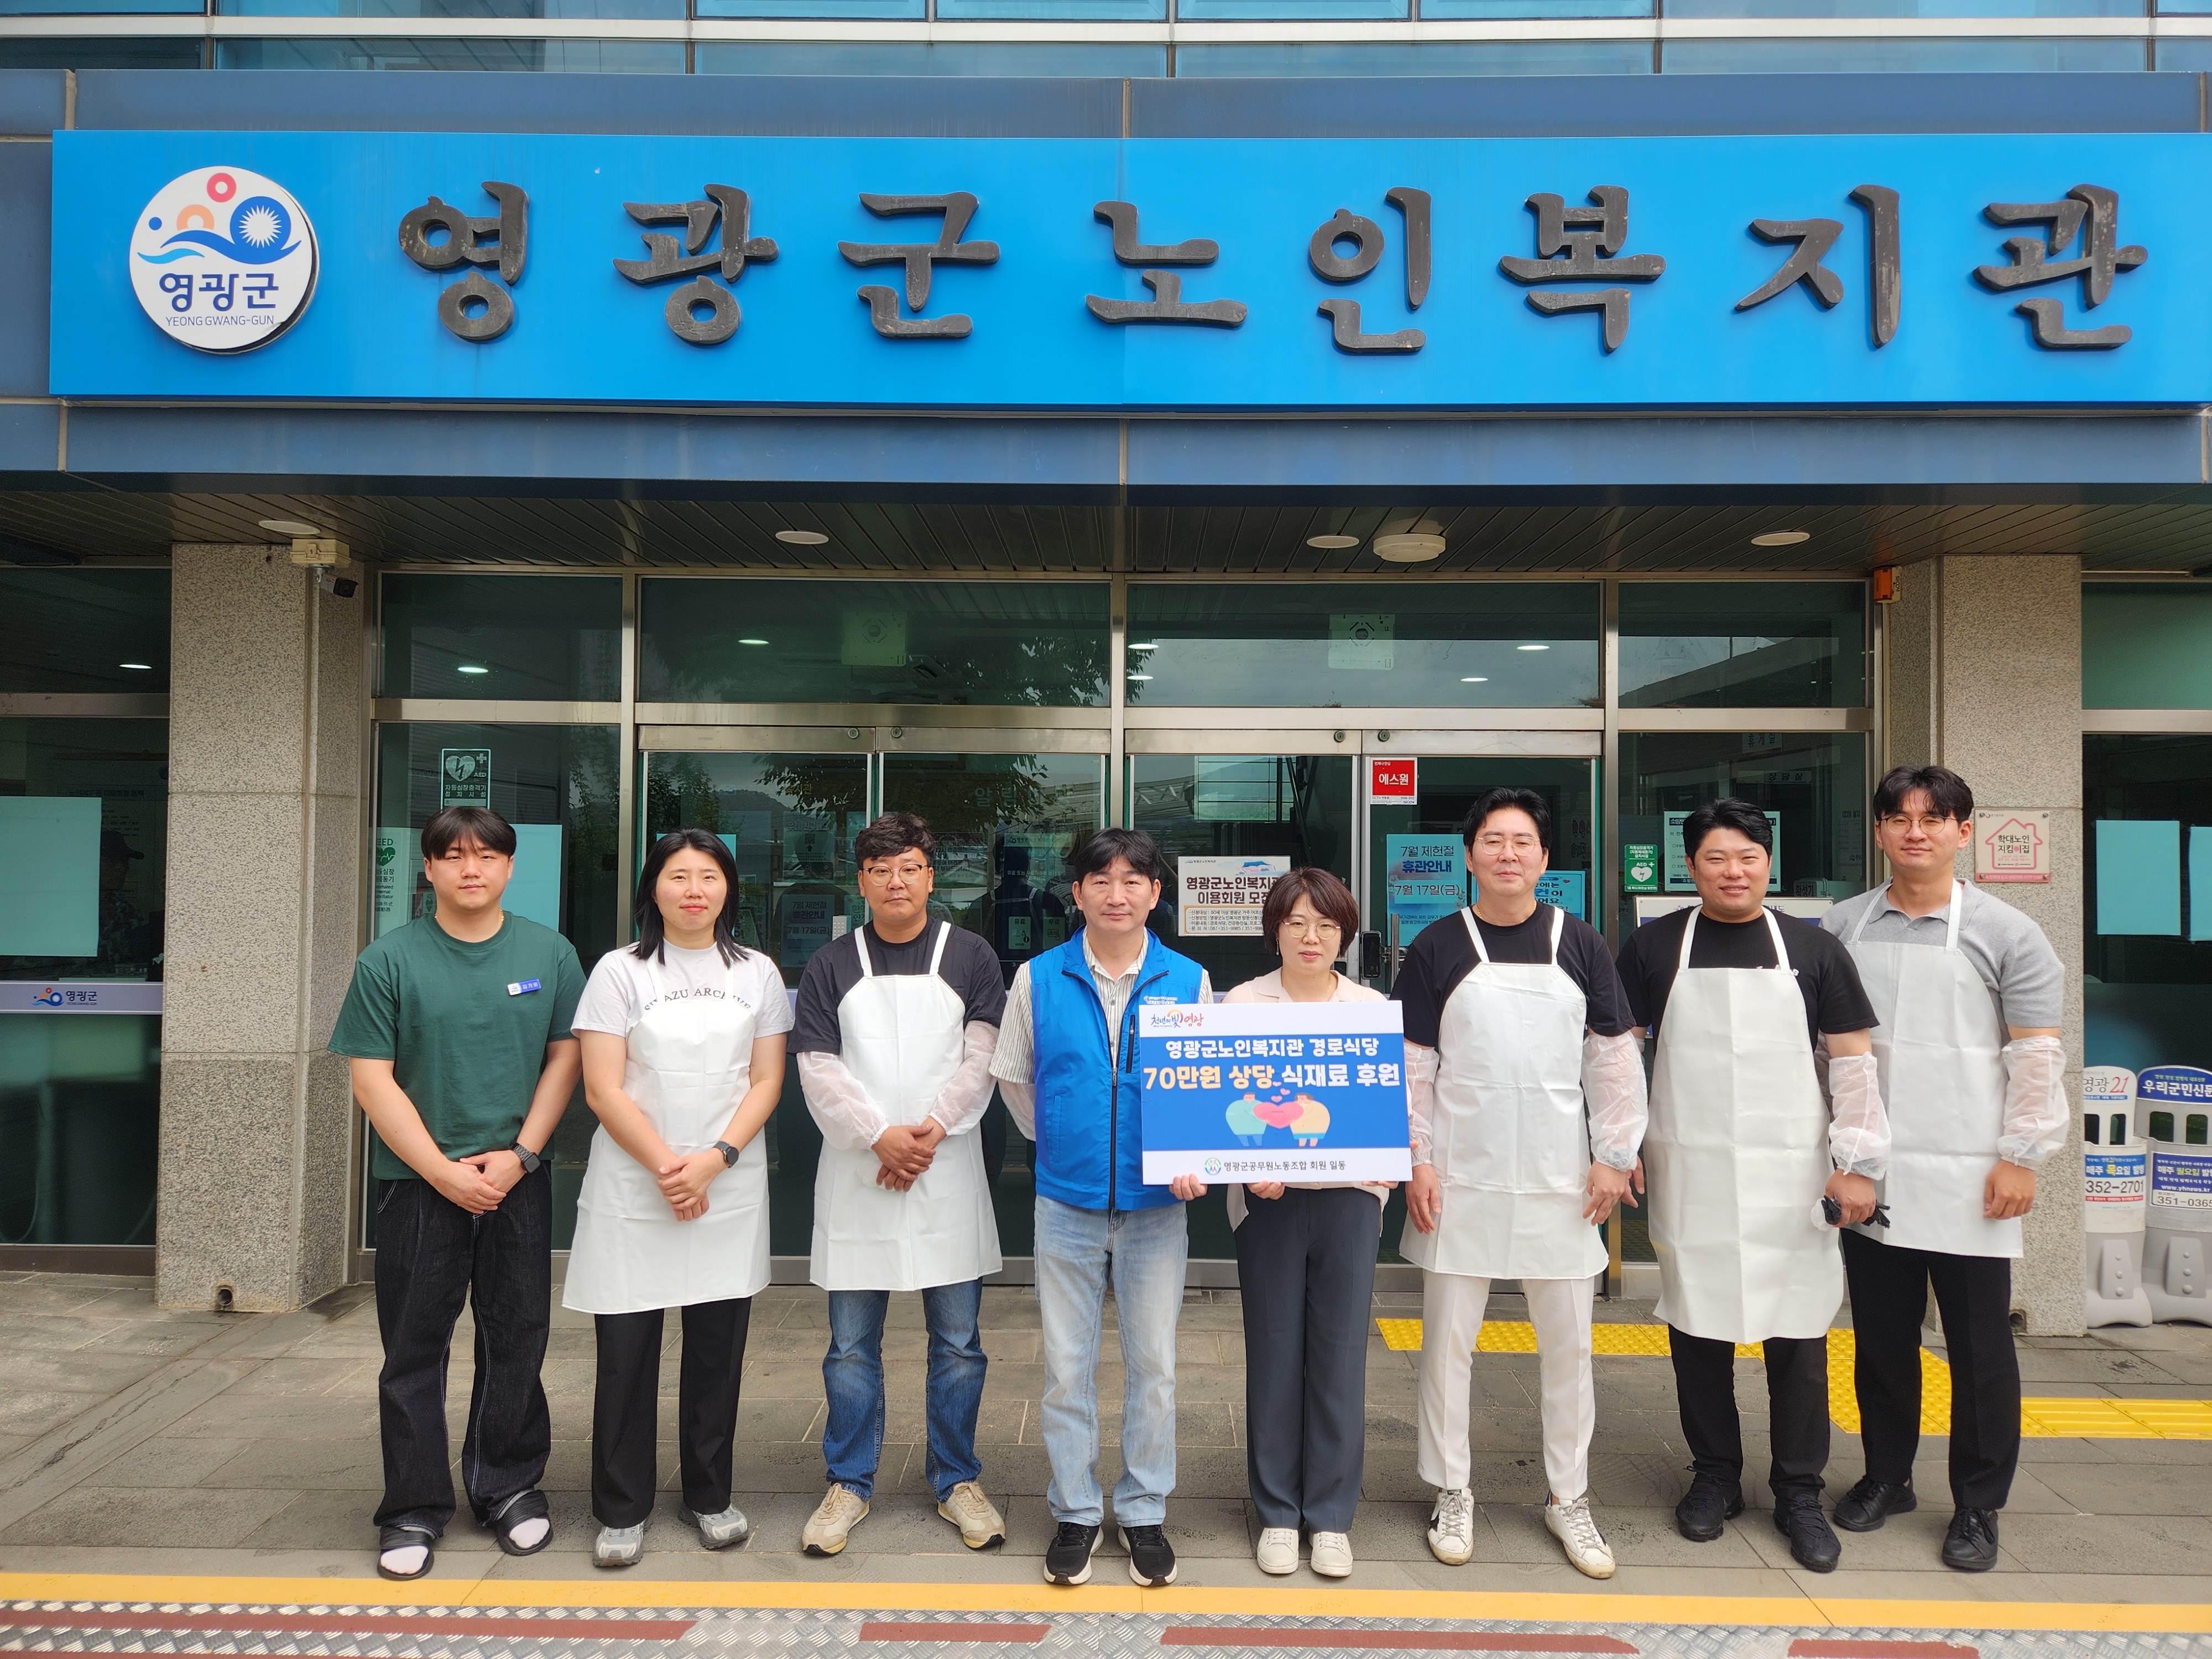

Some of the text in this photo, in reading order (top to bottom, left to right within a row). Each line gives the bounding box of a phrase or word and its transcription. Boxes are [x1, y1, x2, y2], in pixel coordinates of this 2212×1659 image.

[159, 273, 279, 313] 영광군
[165, 315, 274, 327] YEONG GWANG-GUN
[1378, 773, 1408, 785] 에스원
[1998, 834, 2030, 844] 학대노인
[1400, 846, 1454, 857] 7월 제헌절
[1998, 845, 2030, 854] 지킴이집
[1402, 860, 1452, 873] 휴관안내
[1395, 884, 1460, 896] 7월 17일(금)
[1198, 891, 1245, 904] 이용회원
[805, 901, 827, 909] 제헌절
[792, 911, 825, 919] 휴관안내
[66, 990, 98, 1001] 영광군
[1184, 1013, 1204, 1027] 영광
[1166, 1038, 1379, 1060] 영광군노인복지관 경로식당
[1142, 1063, 1400, 1090] 70만원 상당 식재료 후원
[1224, 1160, 1347, 1172] 영광군공무원노동조합 회원 일동
[2157, 1166, 2174, 1175] 매주
[2176, 1167, 2200, 1177] 월요일
[2085, 1180, 2143, 1193] 352-2701
